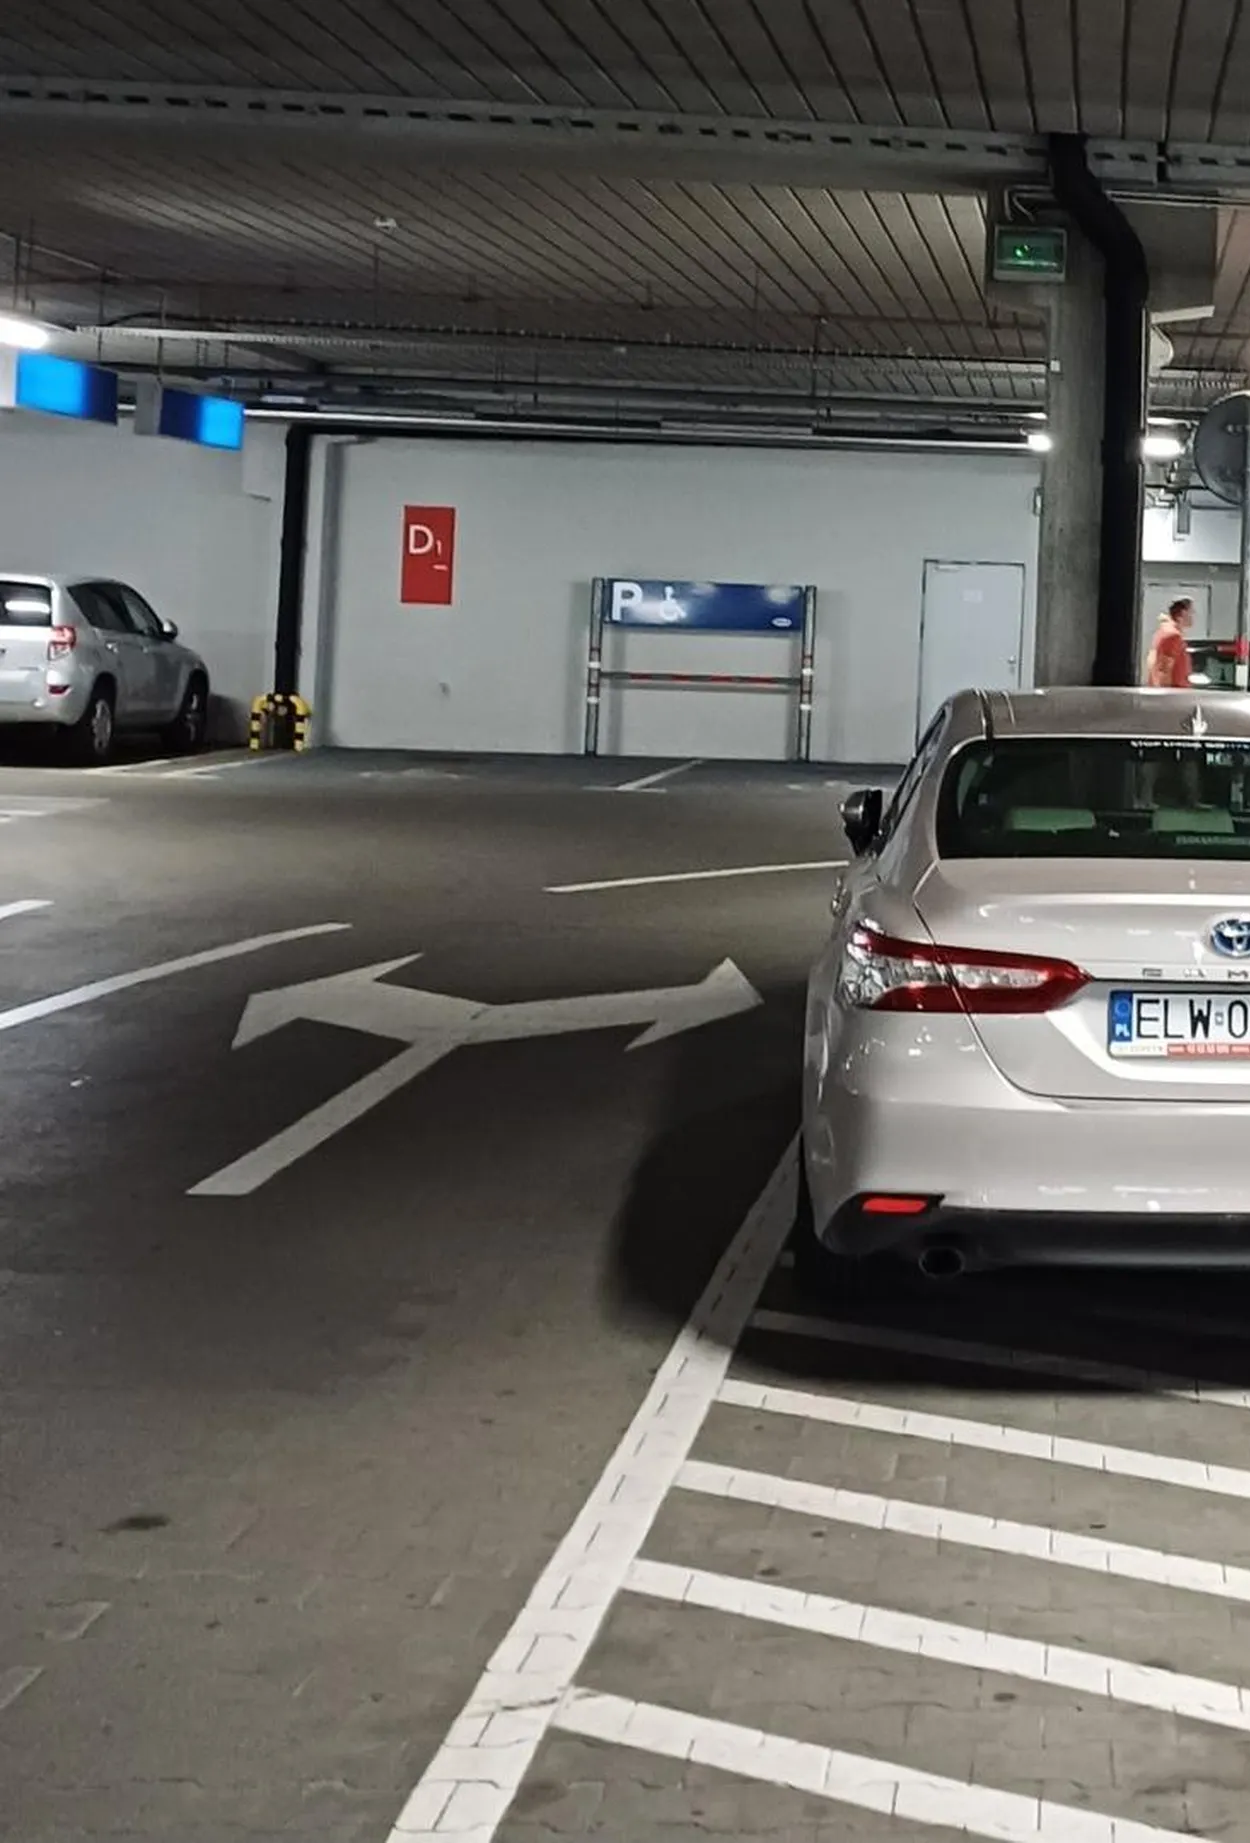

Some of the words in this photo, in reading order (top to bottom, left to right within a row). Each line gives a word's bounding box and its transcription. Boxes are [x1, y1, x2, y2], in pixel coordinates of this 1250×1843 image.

[612, 581, 643, 621] P
[1115, 1023, 1130, 1037] PL
[1136, 998, 1212, 1039] ELW
